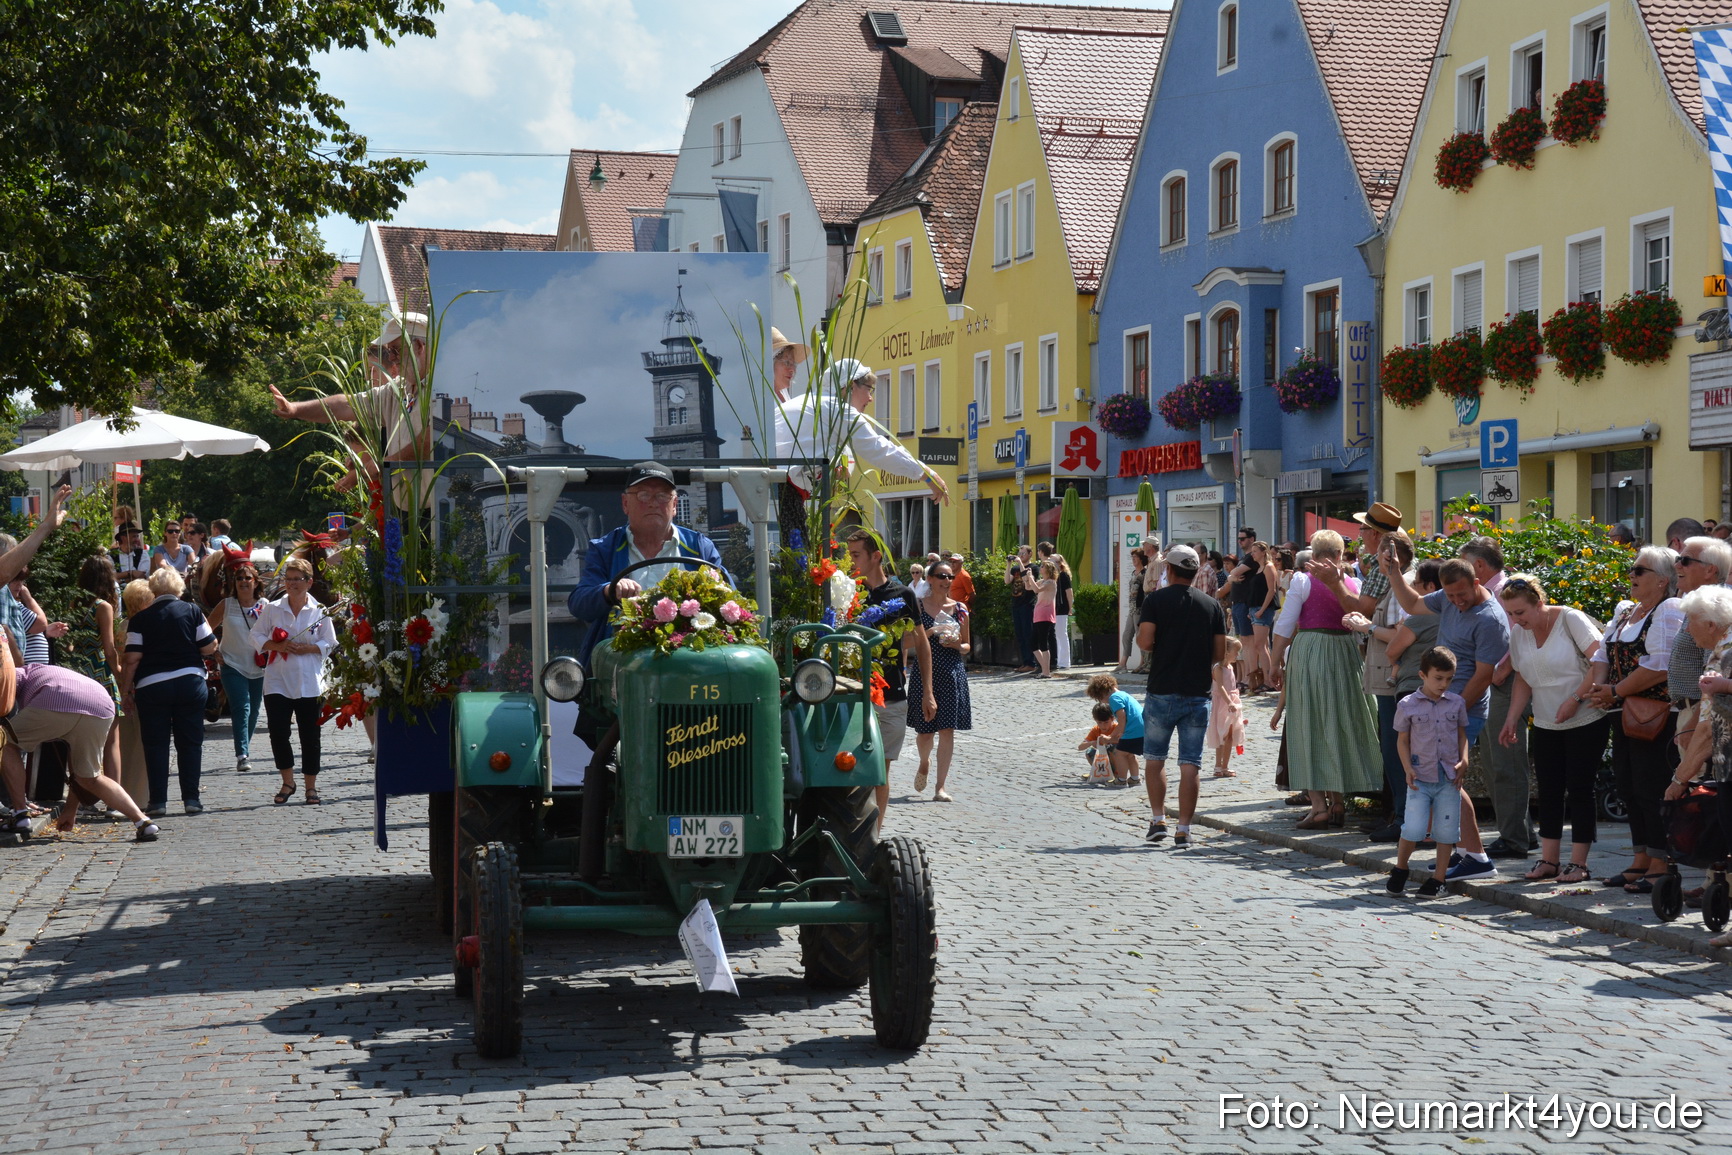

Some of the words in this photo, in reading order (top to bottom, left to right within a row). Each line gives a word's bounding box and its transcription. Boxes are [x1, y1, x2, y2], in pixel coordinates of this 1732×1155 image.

[883, 331, 912, 361] HOTEL
[920, 326, 955, 351] Lehmeier
[1349, 324, 1369, 341] CAFÉ
[1350, 346, 1367, 436] WITTL
[970, 407, 976, 435] P
[993, 441, 1016, 458] TAIFU
[1017, 434, 1023, 463] P
[1489, 426, 1510, 463] P
[922, 454, 956, 462] TAIFUN
[1118, 441, 1201, 477] APOTHEKE
[1116, 499, 1133, 508] RATHAUS
[1175, 493, 1195, 503] RATHAUS
[1195, 490, 1217, 501] APOTHEKE
[690, 684, 699, 700] F
[702, 684, 720, 700] 15
[665, 714, 720, 746] Fendt
[667, 732, 747, 769] Dieselross
[682, 818, 706, 836] NM
[674, 837, 698, 855] AW
[705, 837, 739, 855] 272
